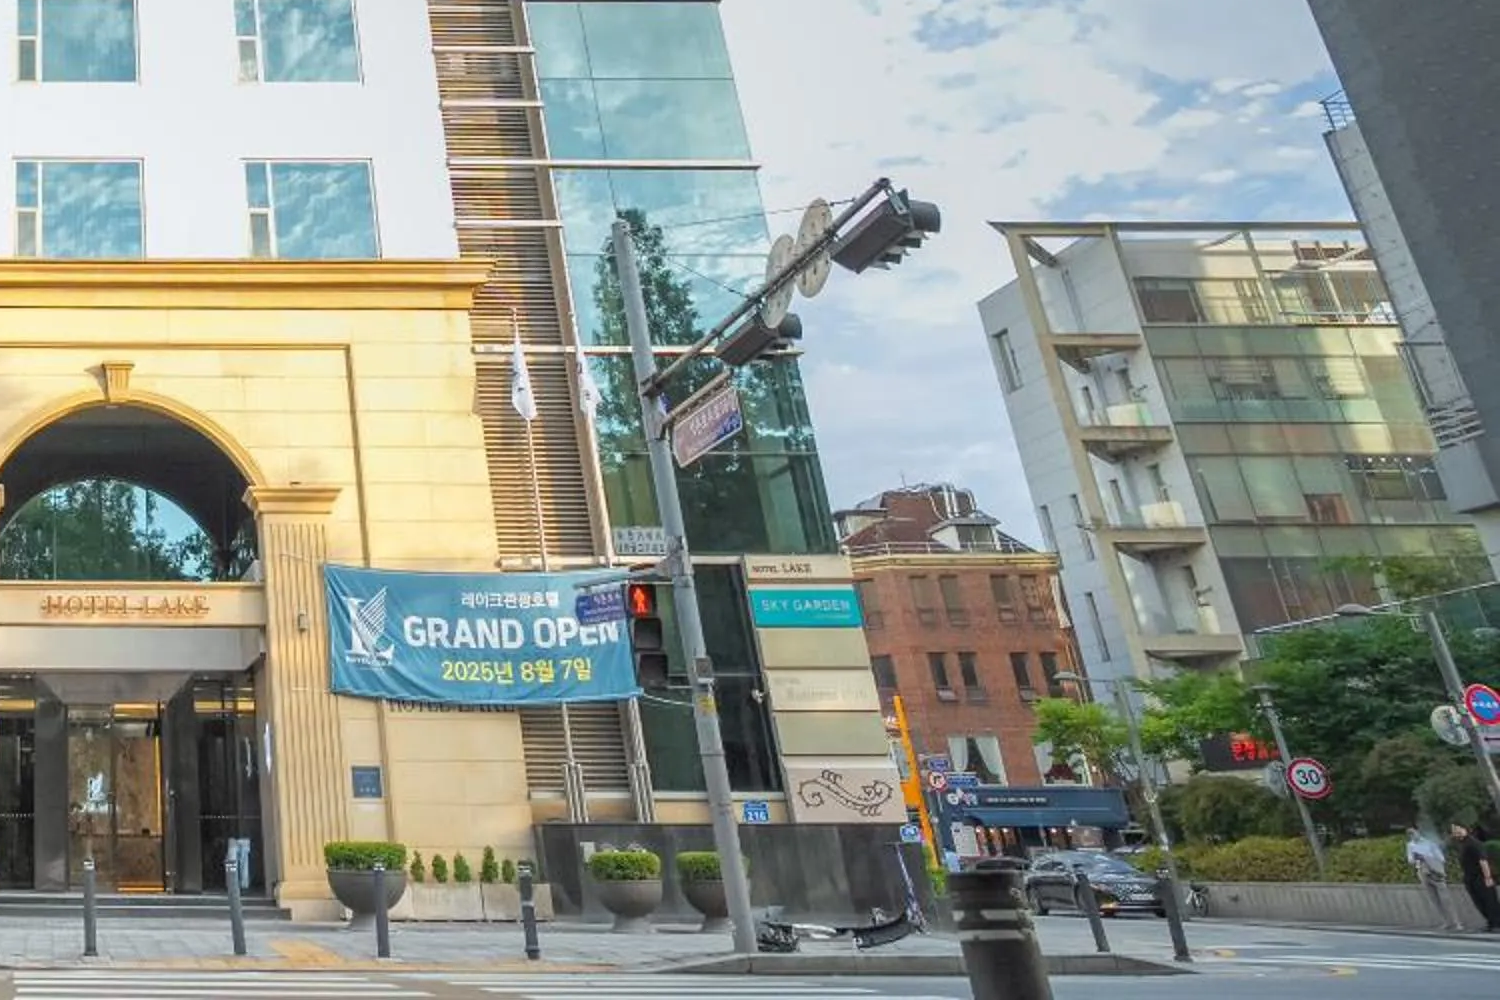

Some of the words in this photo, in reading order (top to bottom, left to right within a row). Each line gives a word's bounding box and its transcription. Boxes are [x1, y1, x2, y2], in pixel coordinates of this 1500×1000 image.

[43, 595, 130, 615] HOTEL
[143, 595, 211, 615] LAKE
[761, 599, 789, 612] SKY
[794, 599, 850, 612] GARDEN
[403, 615, 524, 649] GRAND
[533, 616, 620, 649] OPEN
[441, 660, 514, 685] 2025년
[520, 658, 555, 684] 8월
[563, 657, 592, 682] 7일
[1296, 769, 1321, 785] 30
